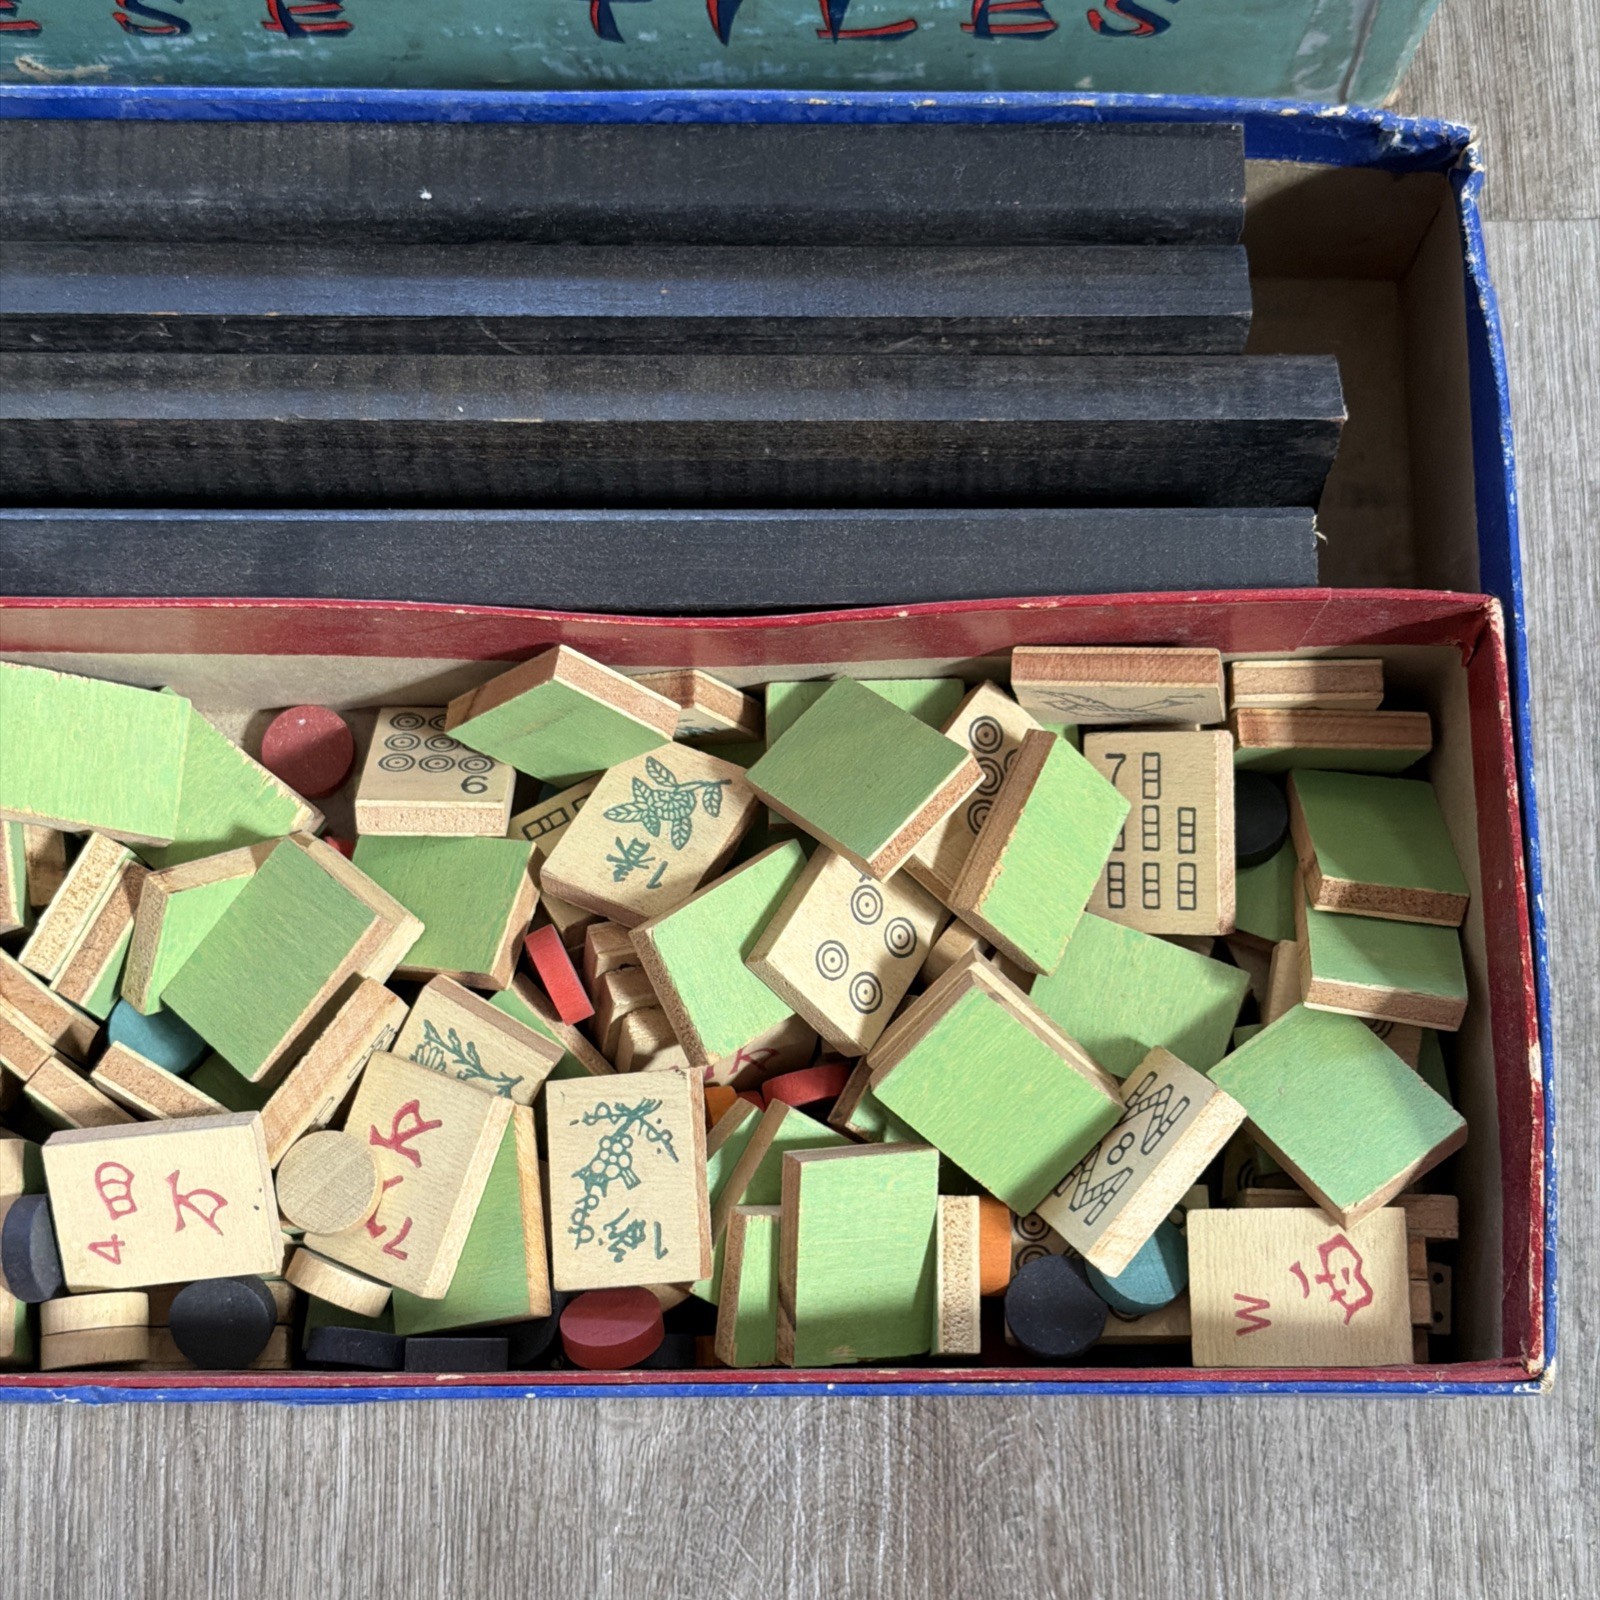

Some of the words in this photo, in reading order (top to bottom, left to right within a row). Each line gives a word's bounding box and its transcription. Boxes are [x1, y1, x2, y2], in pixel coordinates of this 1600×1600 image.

[1104, 752, 1127, 788] 7
[1106, 1131, 1135, 1166] 8
[88, 1233, 126, 1265] 4
[1233, 1293, 1272, 1337] W
